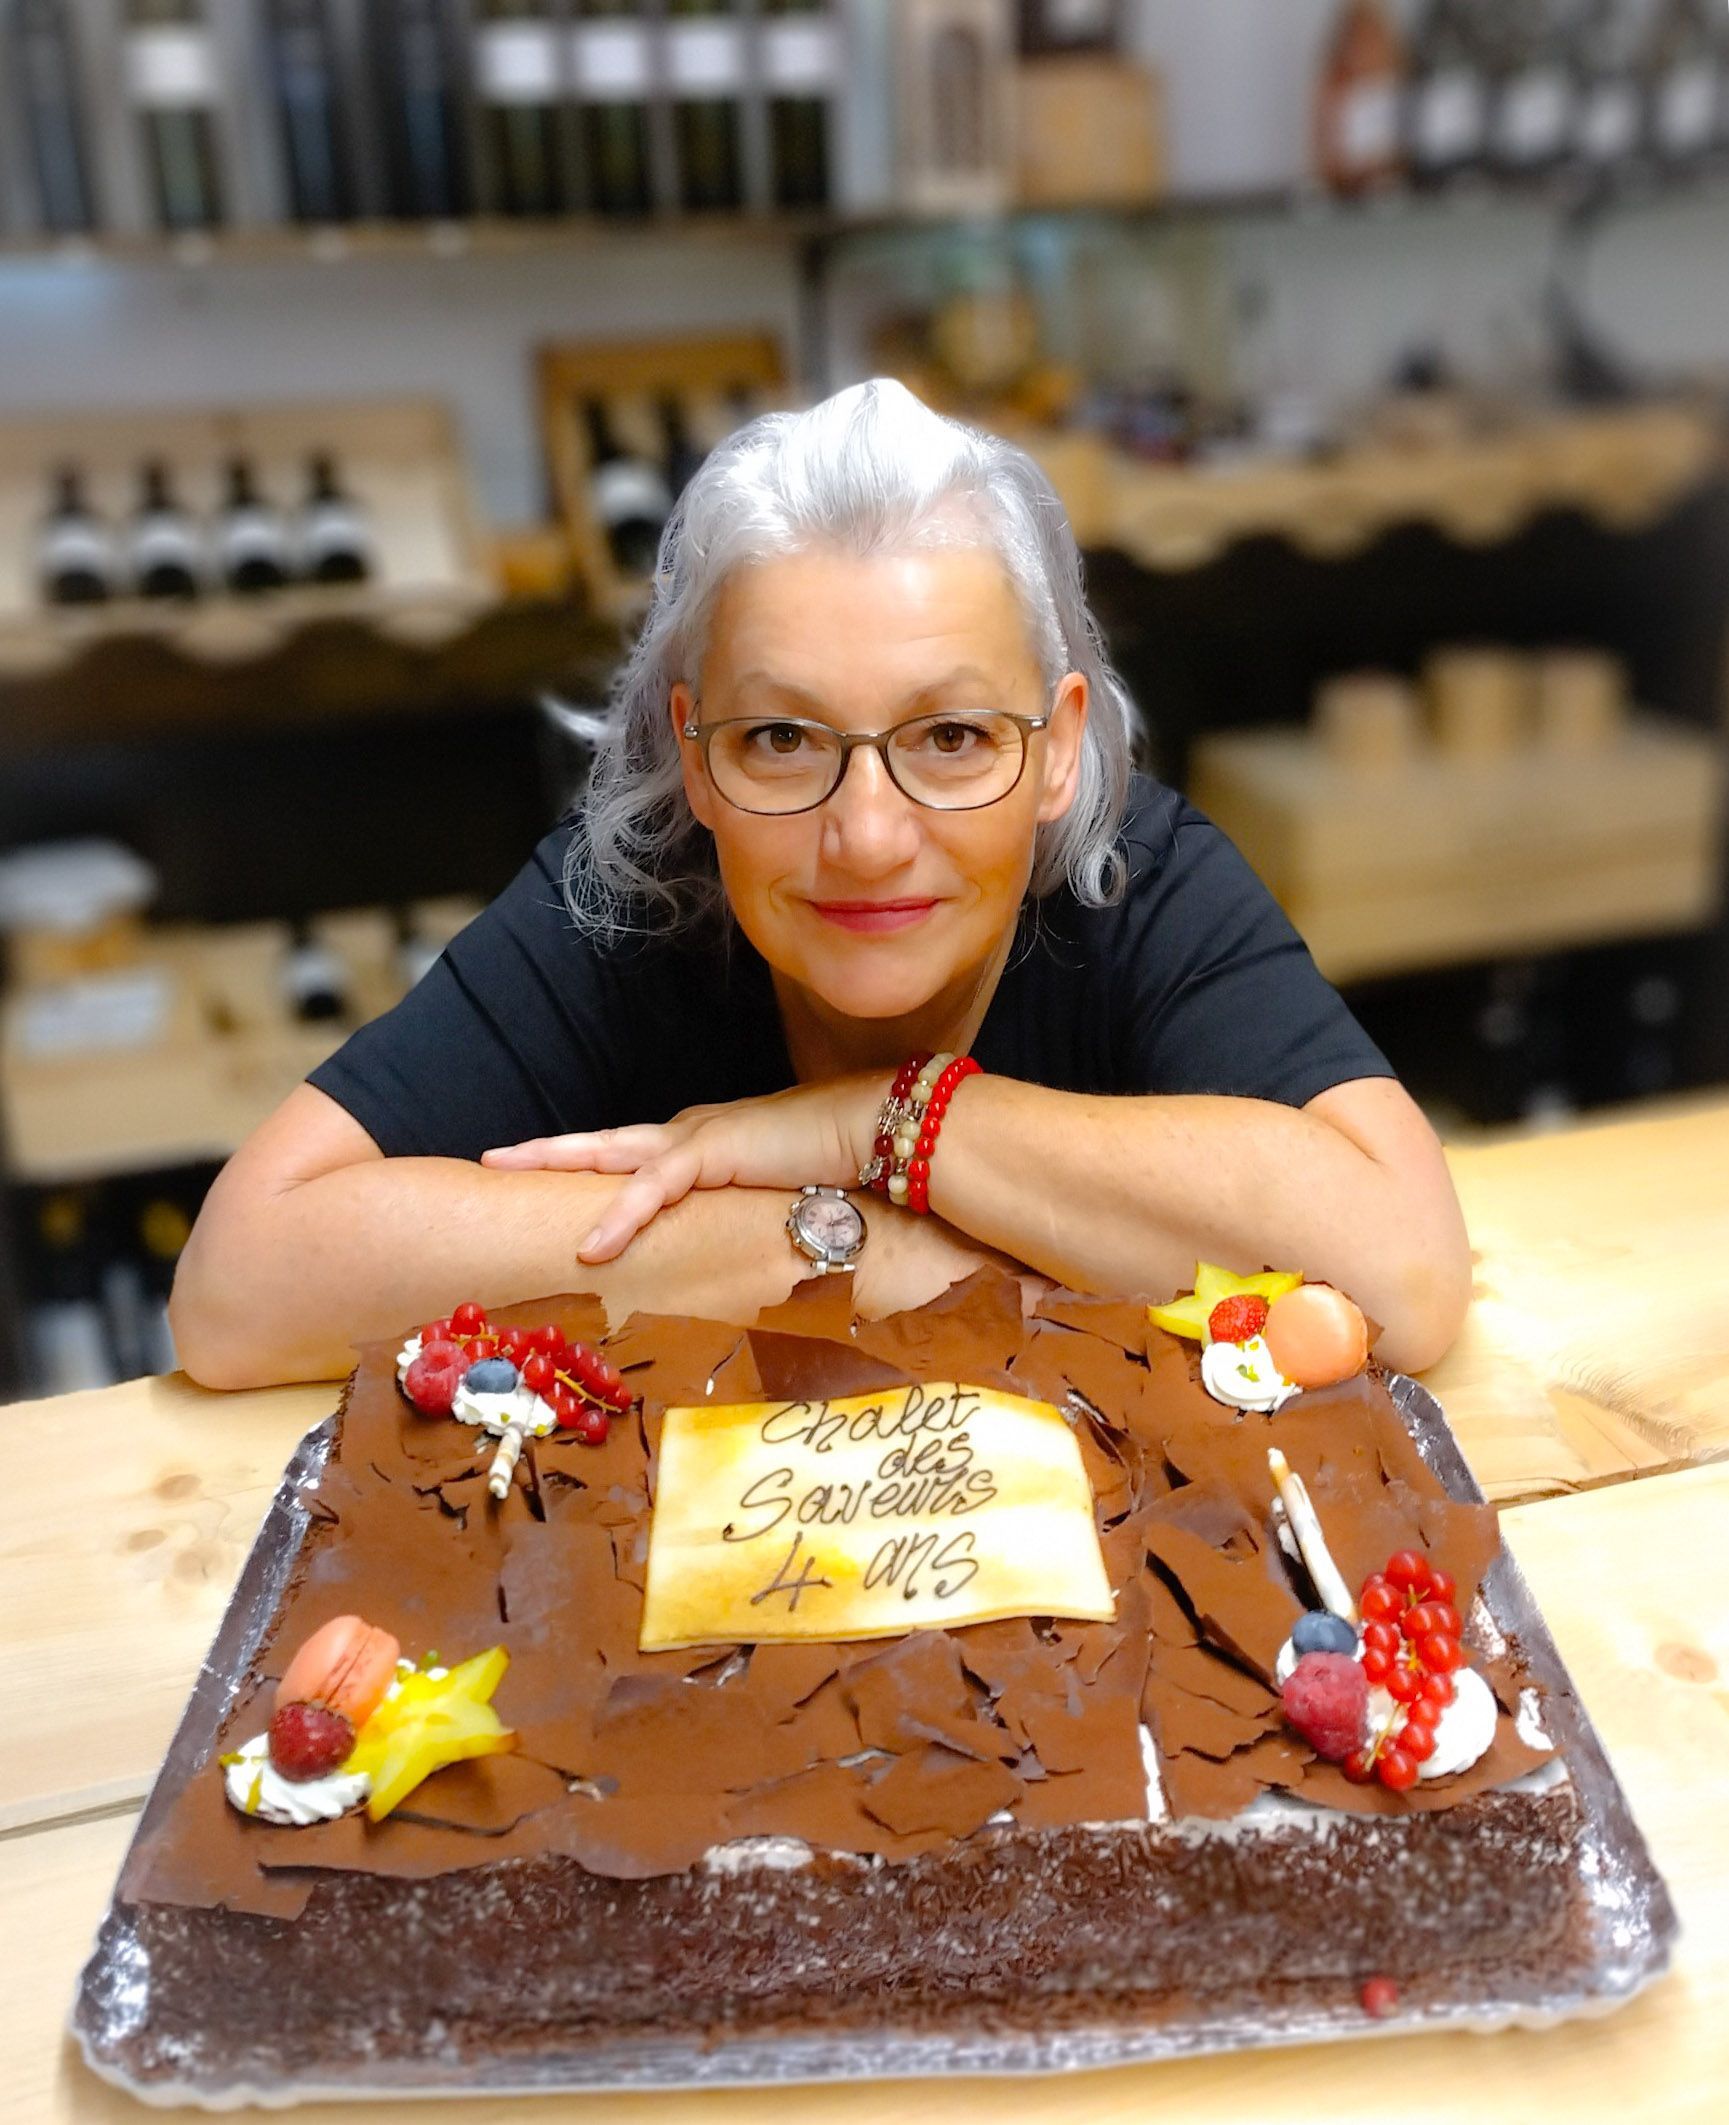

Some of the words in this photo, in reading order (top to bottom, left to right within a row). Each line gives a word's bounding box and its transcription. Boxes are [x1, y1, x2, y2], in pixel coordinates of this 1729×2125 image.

[878, 1432, 974, 1479] des
[723, 1468, 998, 1541] Saveurs
[751, 1532, 832, 1613] 4
[862, 1531, 981, 1600] ans
